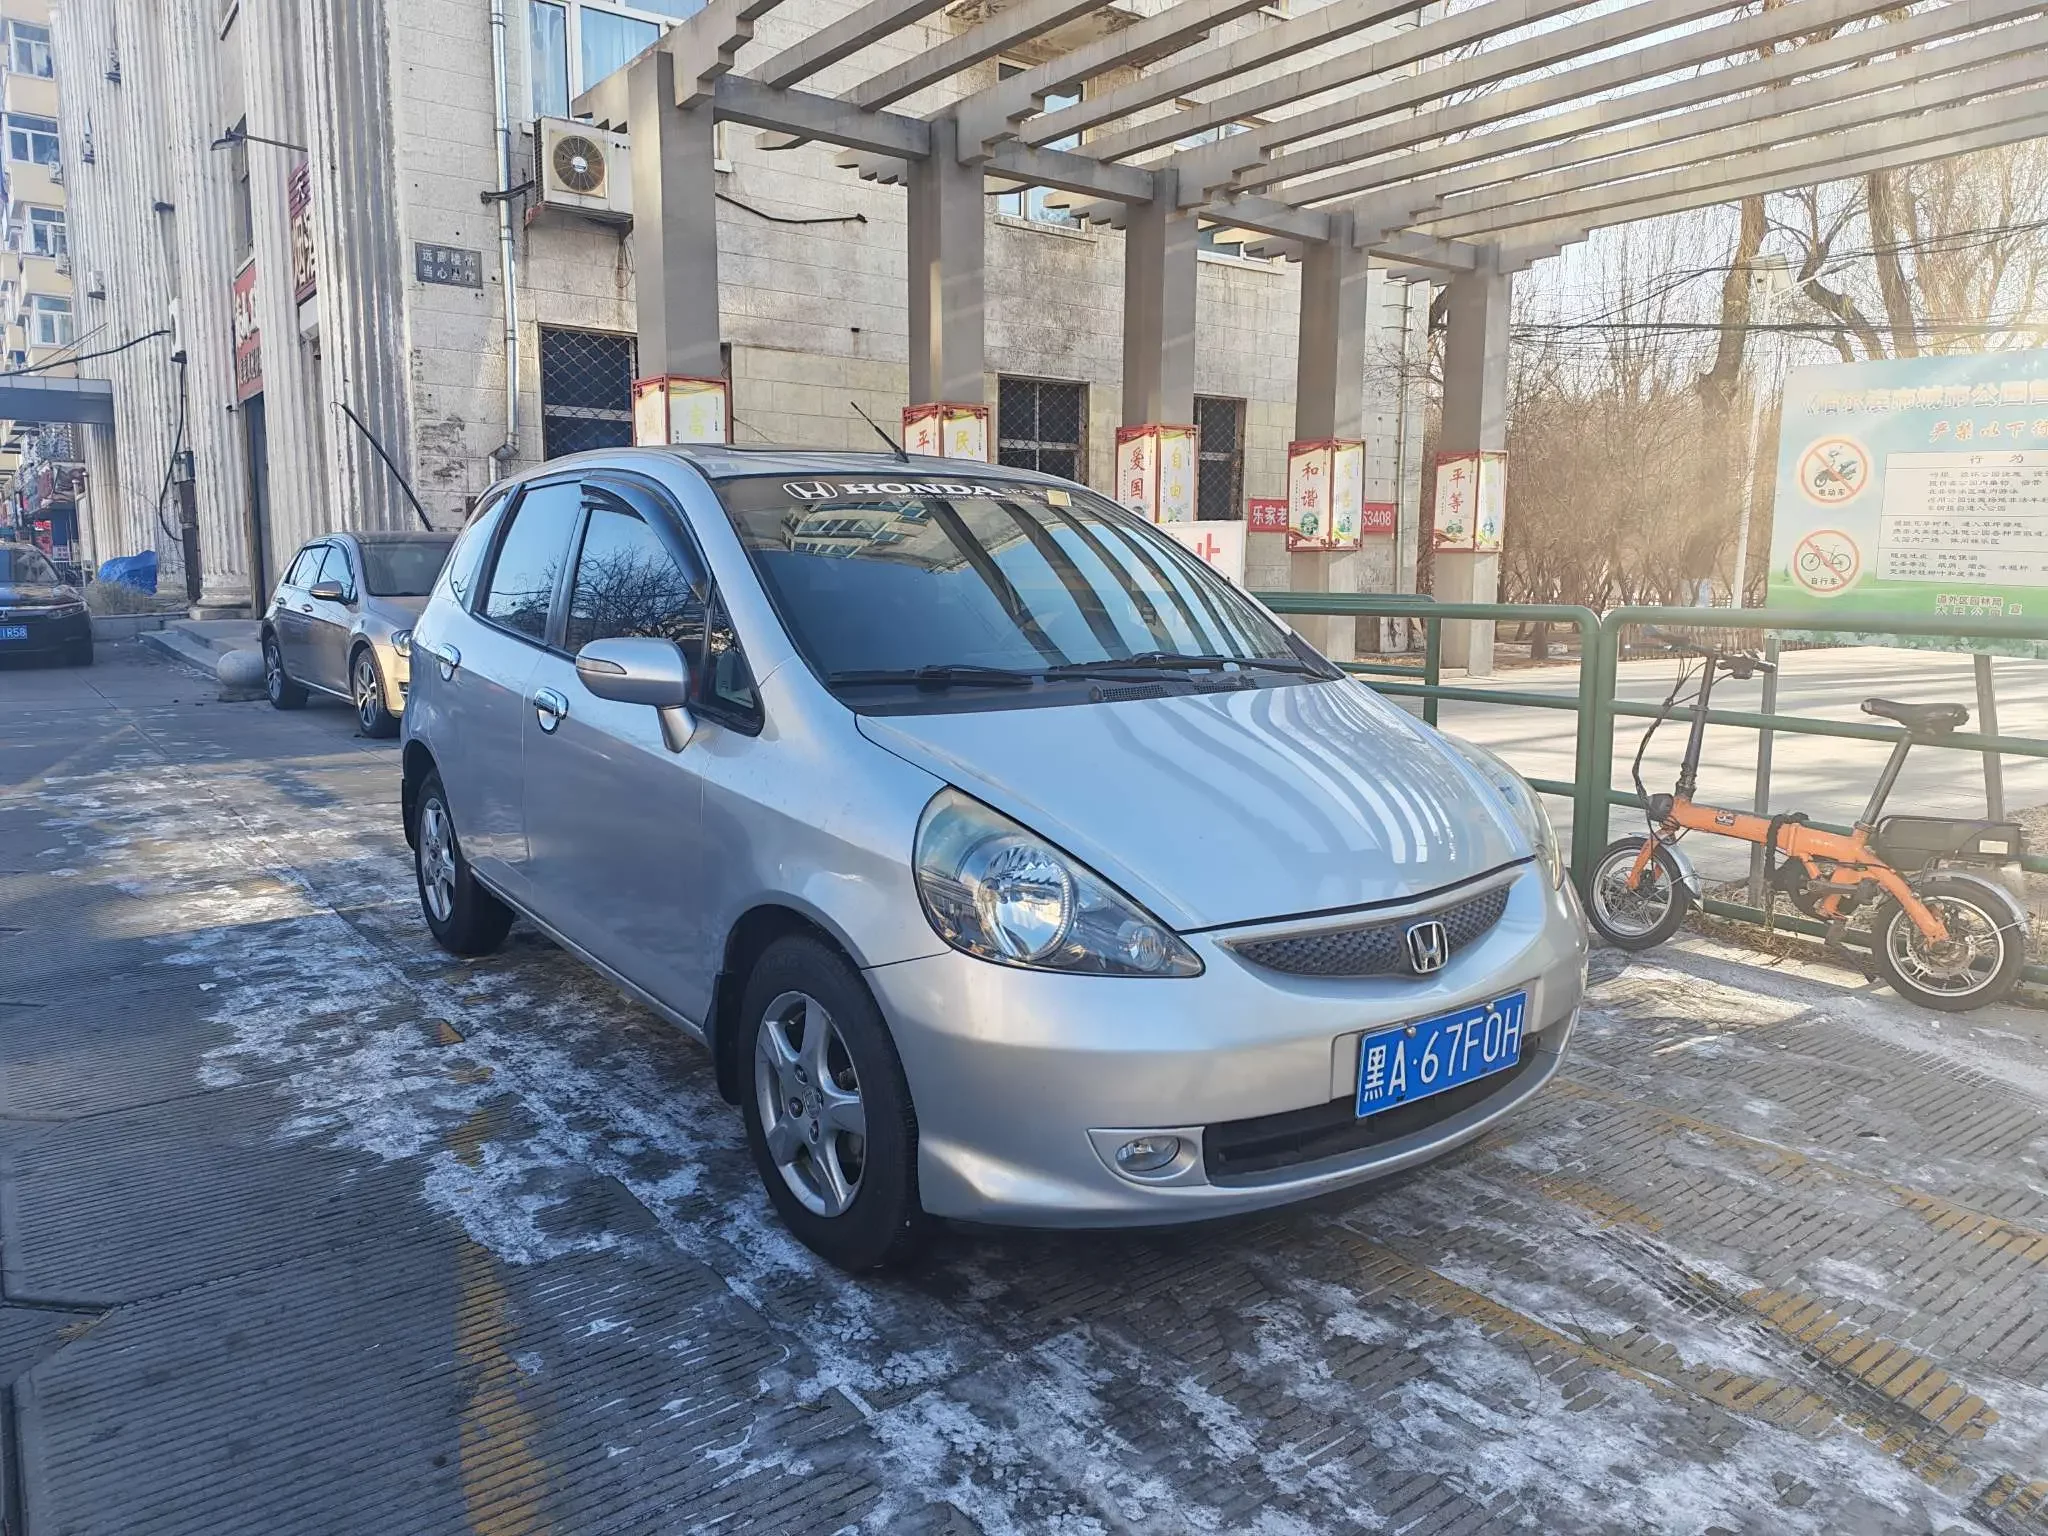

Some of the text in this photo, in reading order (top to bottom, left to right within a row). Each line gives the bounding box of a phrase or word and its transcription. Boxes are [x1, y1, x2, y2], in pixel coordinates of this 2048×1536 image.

[838, 482, 1006, 498] HONDA
[1130, 446, 1145, 500] 爱国
[1169, 446, 1182, 499] 自由
[1301, 461, 1320, 509] 和谐
[1448, 467, 1466, 514] 平等
[1818, 488, 1846, 497] 电动车
[1252, 504, 1287, 526] 乐家老
[1811, 577, 1840, 585] 自行车
[1364, 1004, 1522, 1102] 黑A·67F0H
